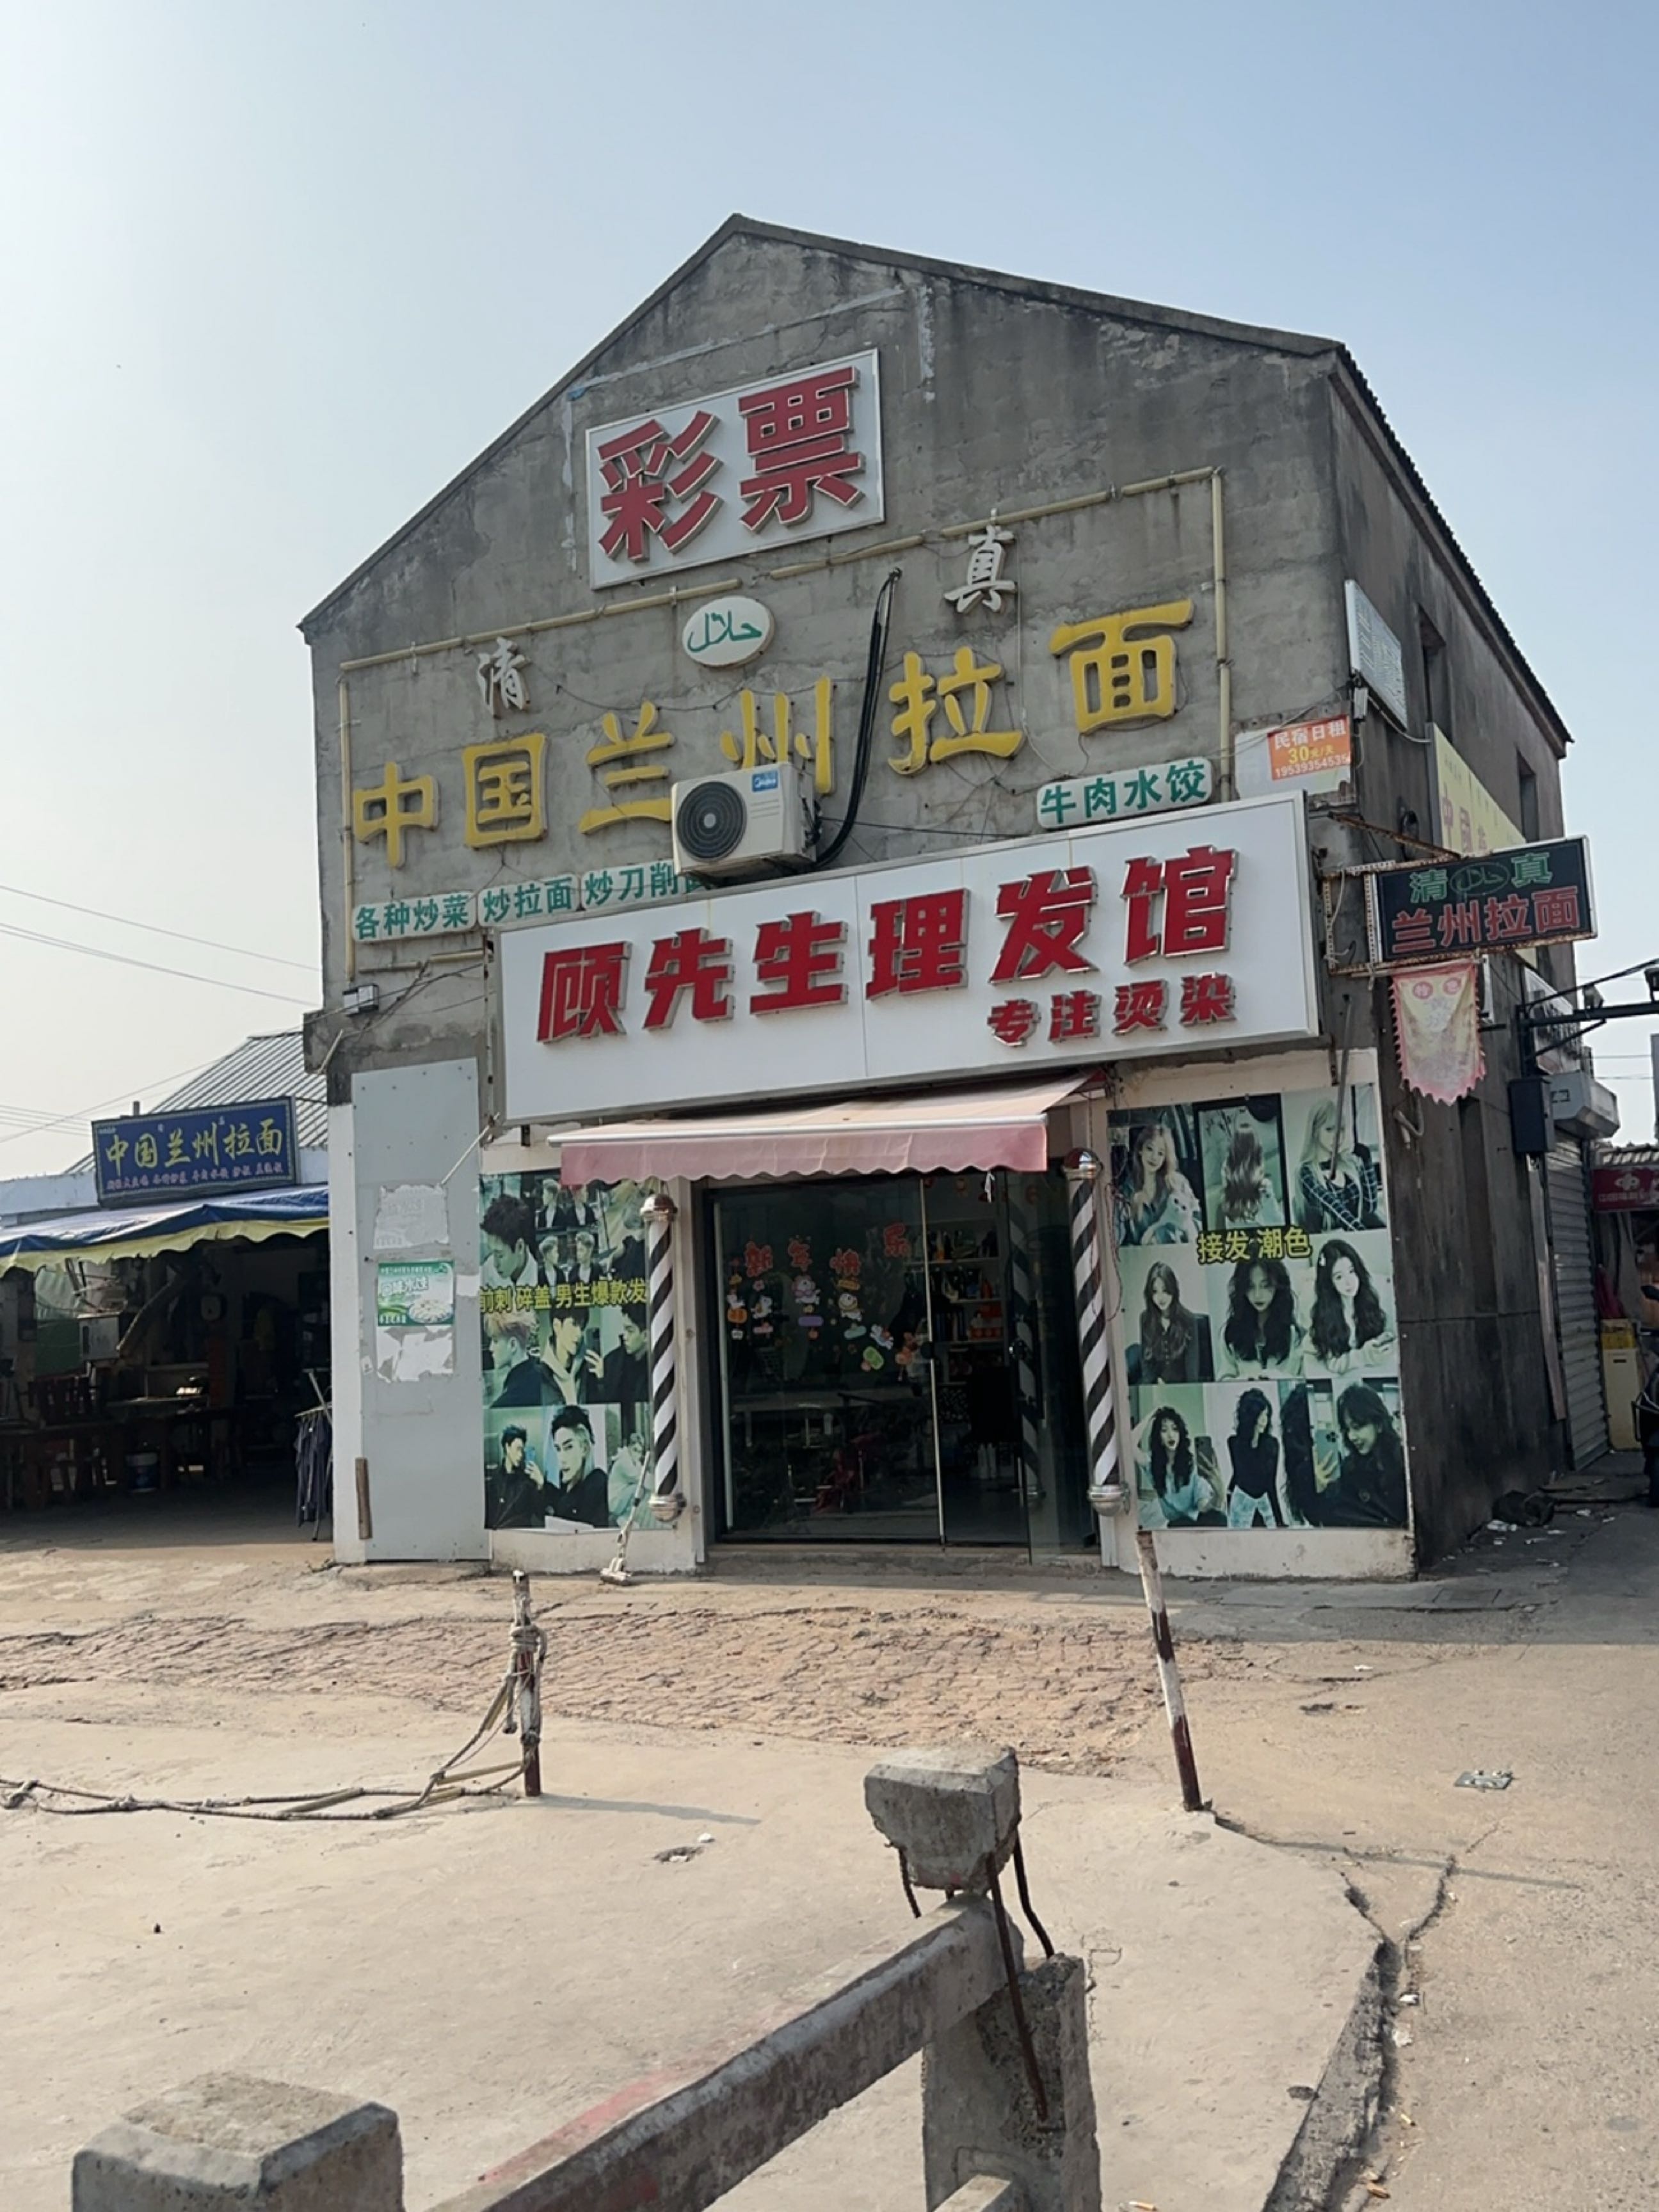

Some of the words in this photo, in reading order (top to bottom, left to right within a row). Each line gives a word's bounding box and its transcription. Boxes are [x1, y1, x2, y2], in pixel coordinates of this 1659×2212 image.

[598, 366, 865, 561] 彩票
[477, 636, 531, 717] 清
[944, 524, 1018, 613] 真
[687, 611, 762, 653] حلال
[353, 598, 1194, 869] 中国兰州拉面
[1275, 720, 1345, 749] 民宿日租
[1041, 760, 1206, 824] 牛肉水饺
[483, 876, 572, 922] 炒拉面
[1409, 869, 1447, 903] 清
[1511, 852, 1553, 888] 真
[355, 894, 468, 940] 各种炒菜
[537, 846, 1238, 1045] 顾先生理发馆
[1391, 885, 1580, 954] 兰州拉面
[988, 972, 1236, 1046] 专注烫染
[106, 1118, 284, 1177] 中国兰州拉面
[1198, 1230, 1251, 1263] 接发
[1257, 1226, 1311, 1259] 潮色
[516, 1284, 551, 1311] 碎盖
[556, 1277, 647, 1309] 男生爆款发
